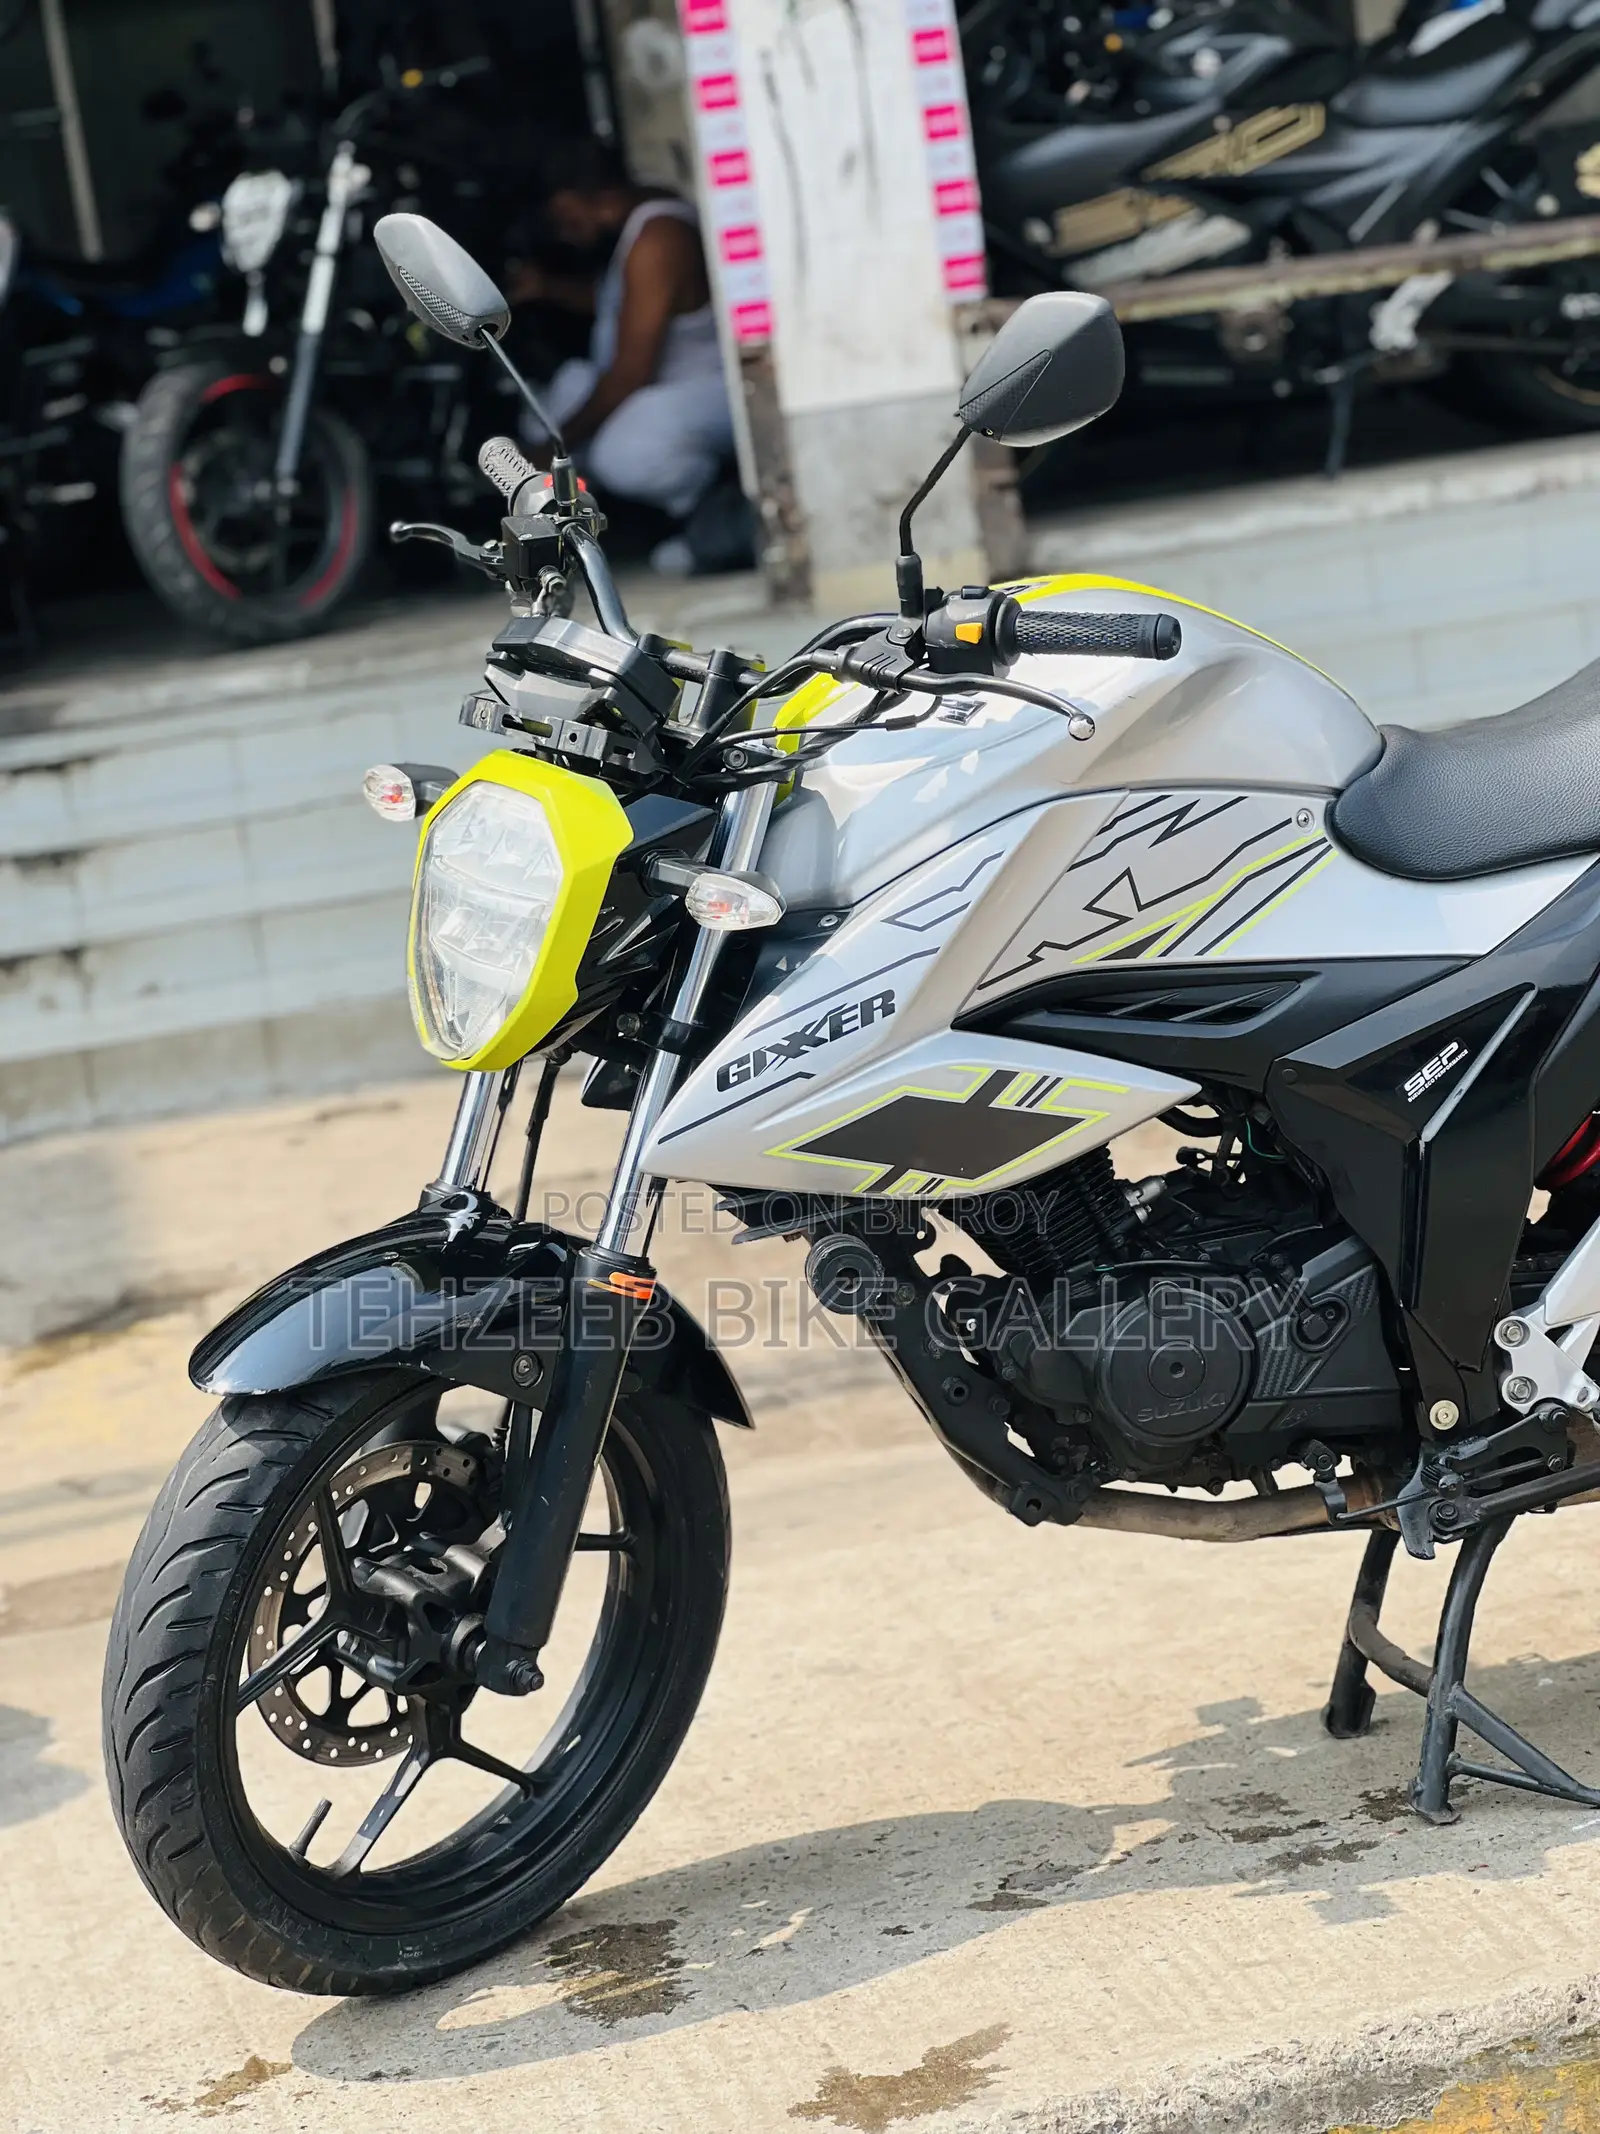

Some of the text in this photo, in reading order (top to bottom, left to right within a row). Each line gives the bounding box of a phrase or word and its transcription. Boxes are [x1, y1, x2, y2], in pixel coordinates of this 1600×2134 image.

[716, 988, 896, 1093] GIXXER
[1404, 1042, 1458, 1096] SEP
[1137, 1392, 1227, 1423] SUZUKI
